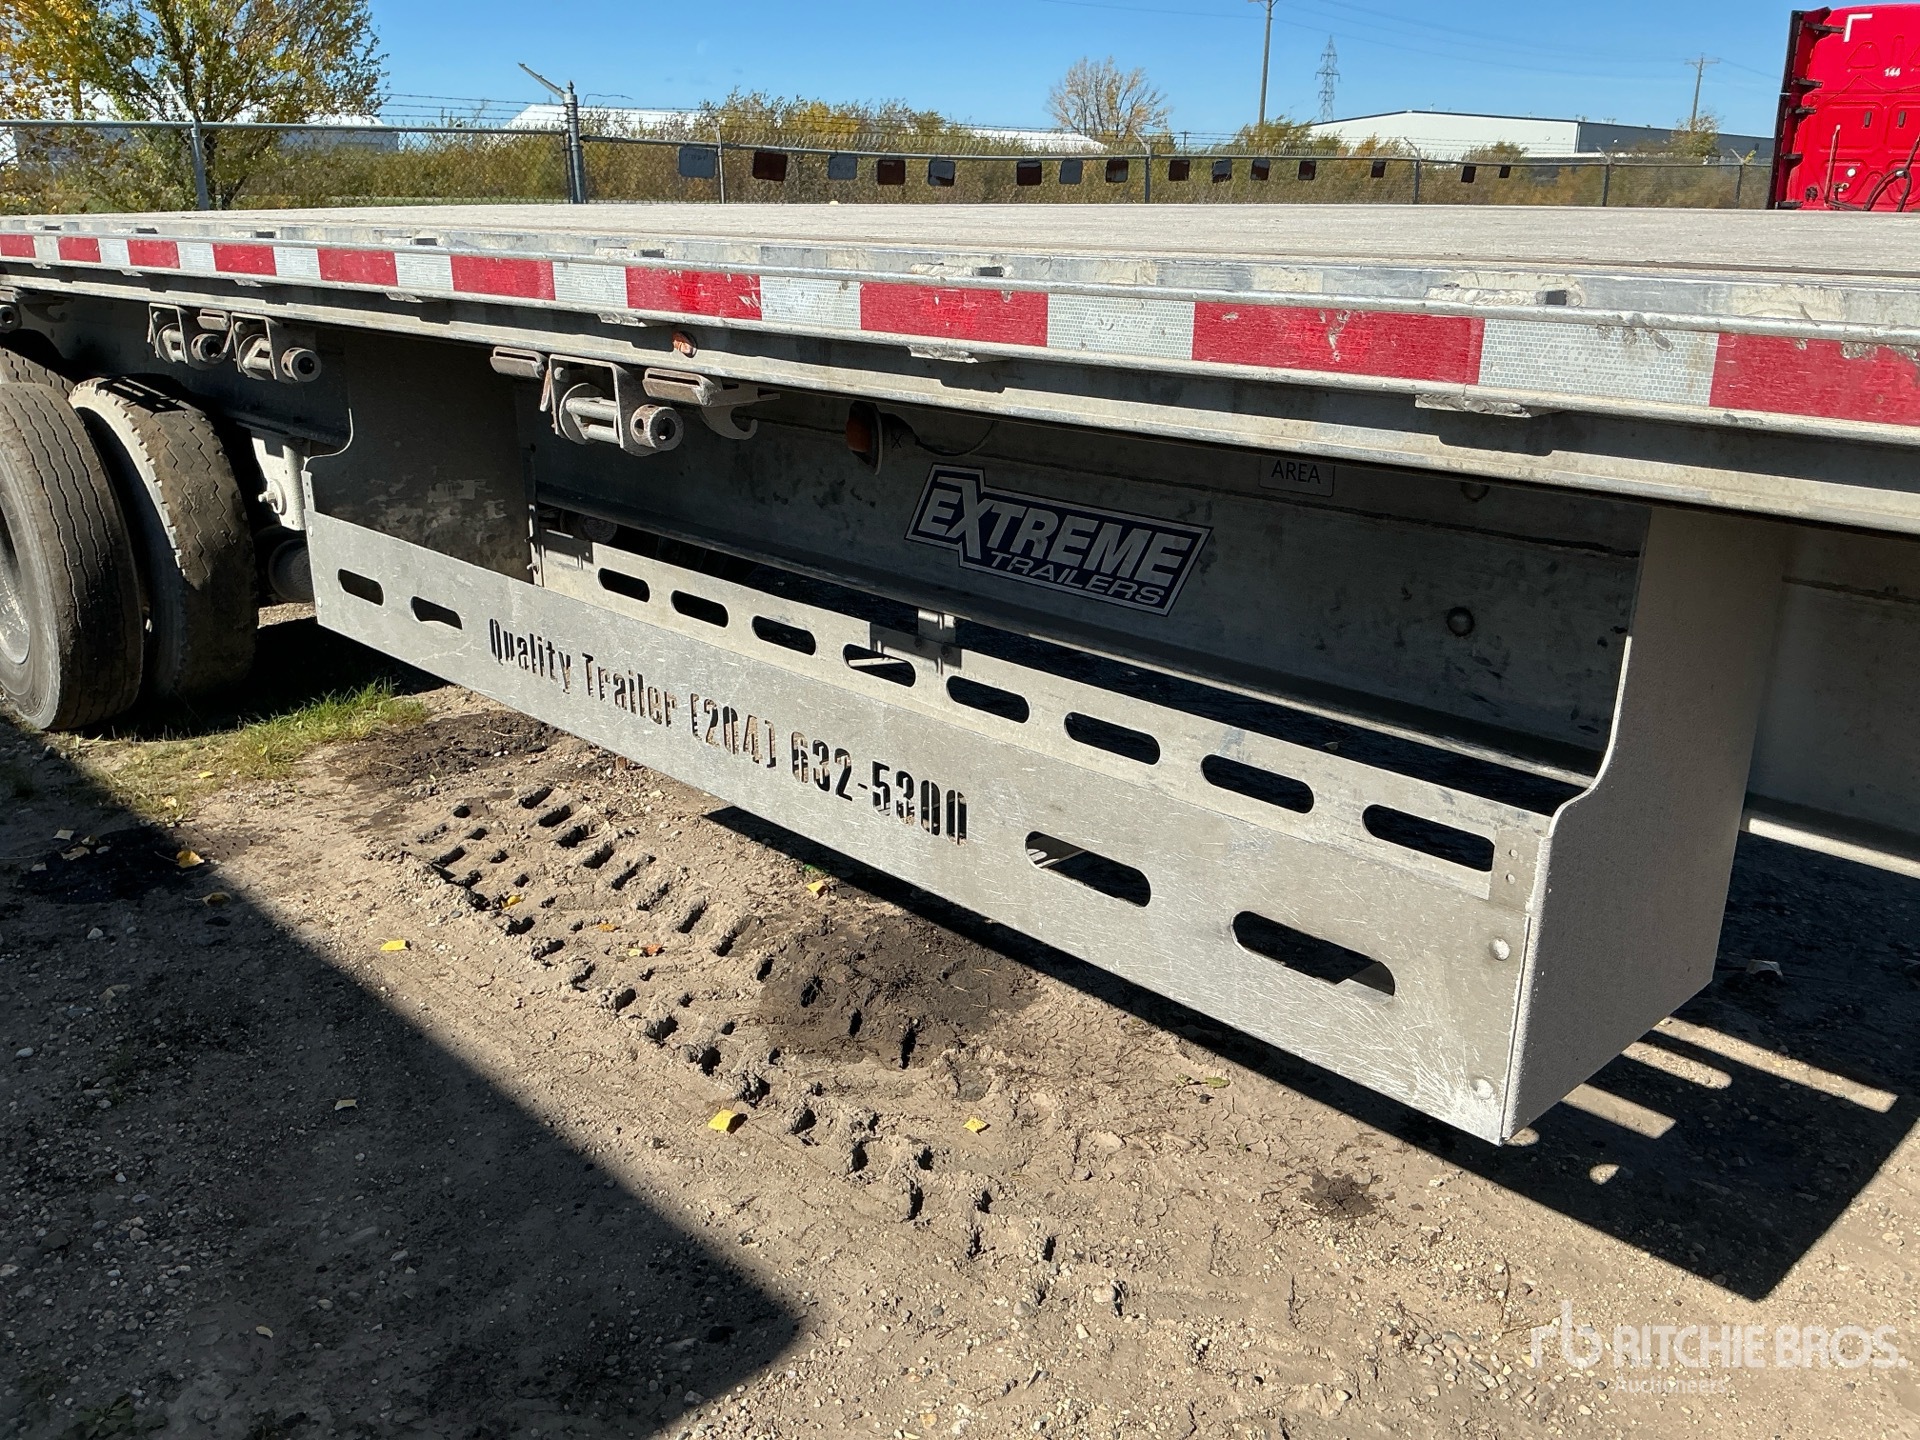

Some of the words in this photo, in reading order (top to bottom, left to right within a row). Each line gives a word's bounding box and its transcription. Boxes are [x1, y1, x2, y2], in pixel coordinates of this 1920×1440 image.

[1270, 459, 1321, 485] AREA
[918, 475, 1193, 588] EXTREME
[990, 552, 1166, 606] TRAILERS
[488, 617, 572, 695] Quality
[581, 652, 678, 728] Trailer
[790, 731, 968, 846] 632-5300
